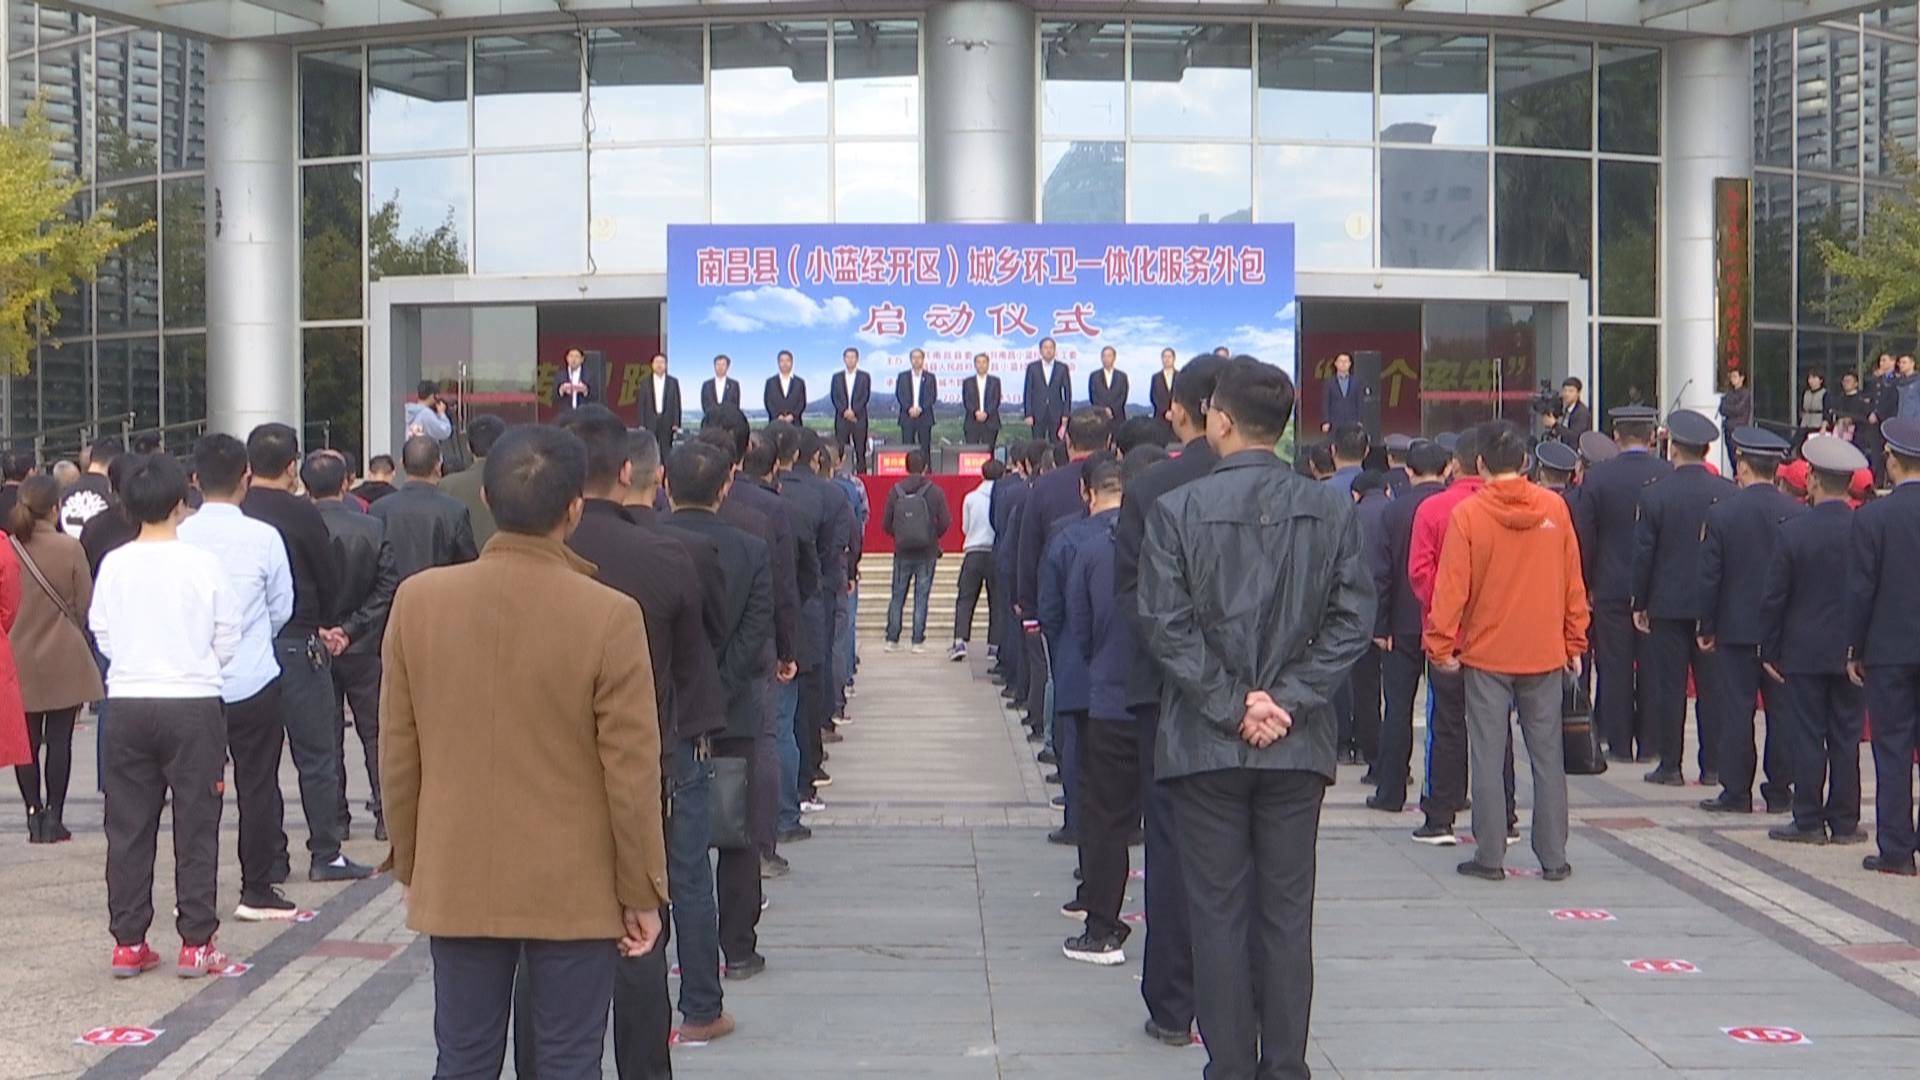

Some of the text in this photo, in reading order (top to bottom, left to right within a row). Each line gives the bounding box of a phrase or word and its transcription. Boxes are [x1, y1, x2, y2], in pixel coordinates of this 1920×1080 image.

[697, 246, 1265, 286] 南昌县（小蓝经开区）城乡环卫一体化服务外包
[859, 302, 1101, 337] 启动仪式
